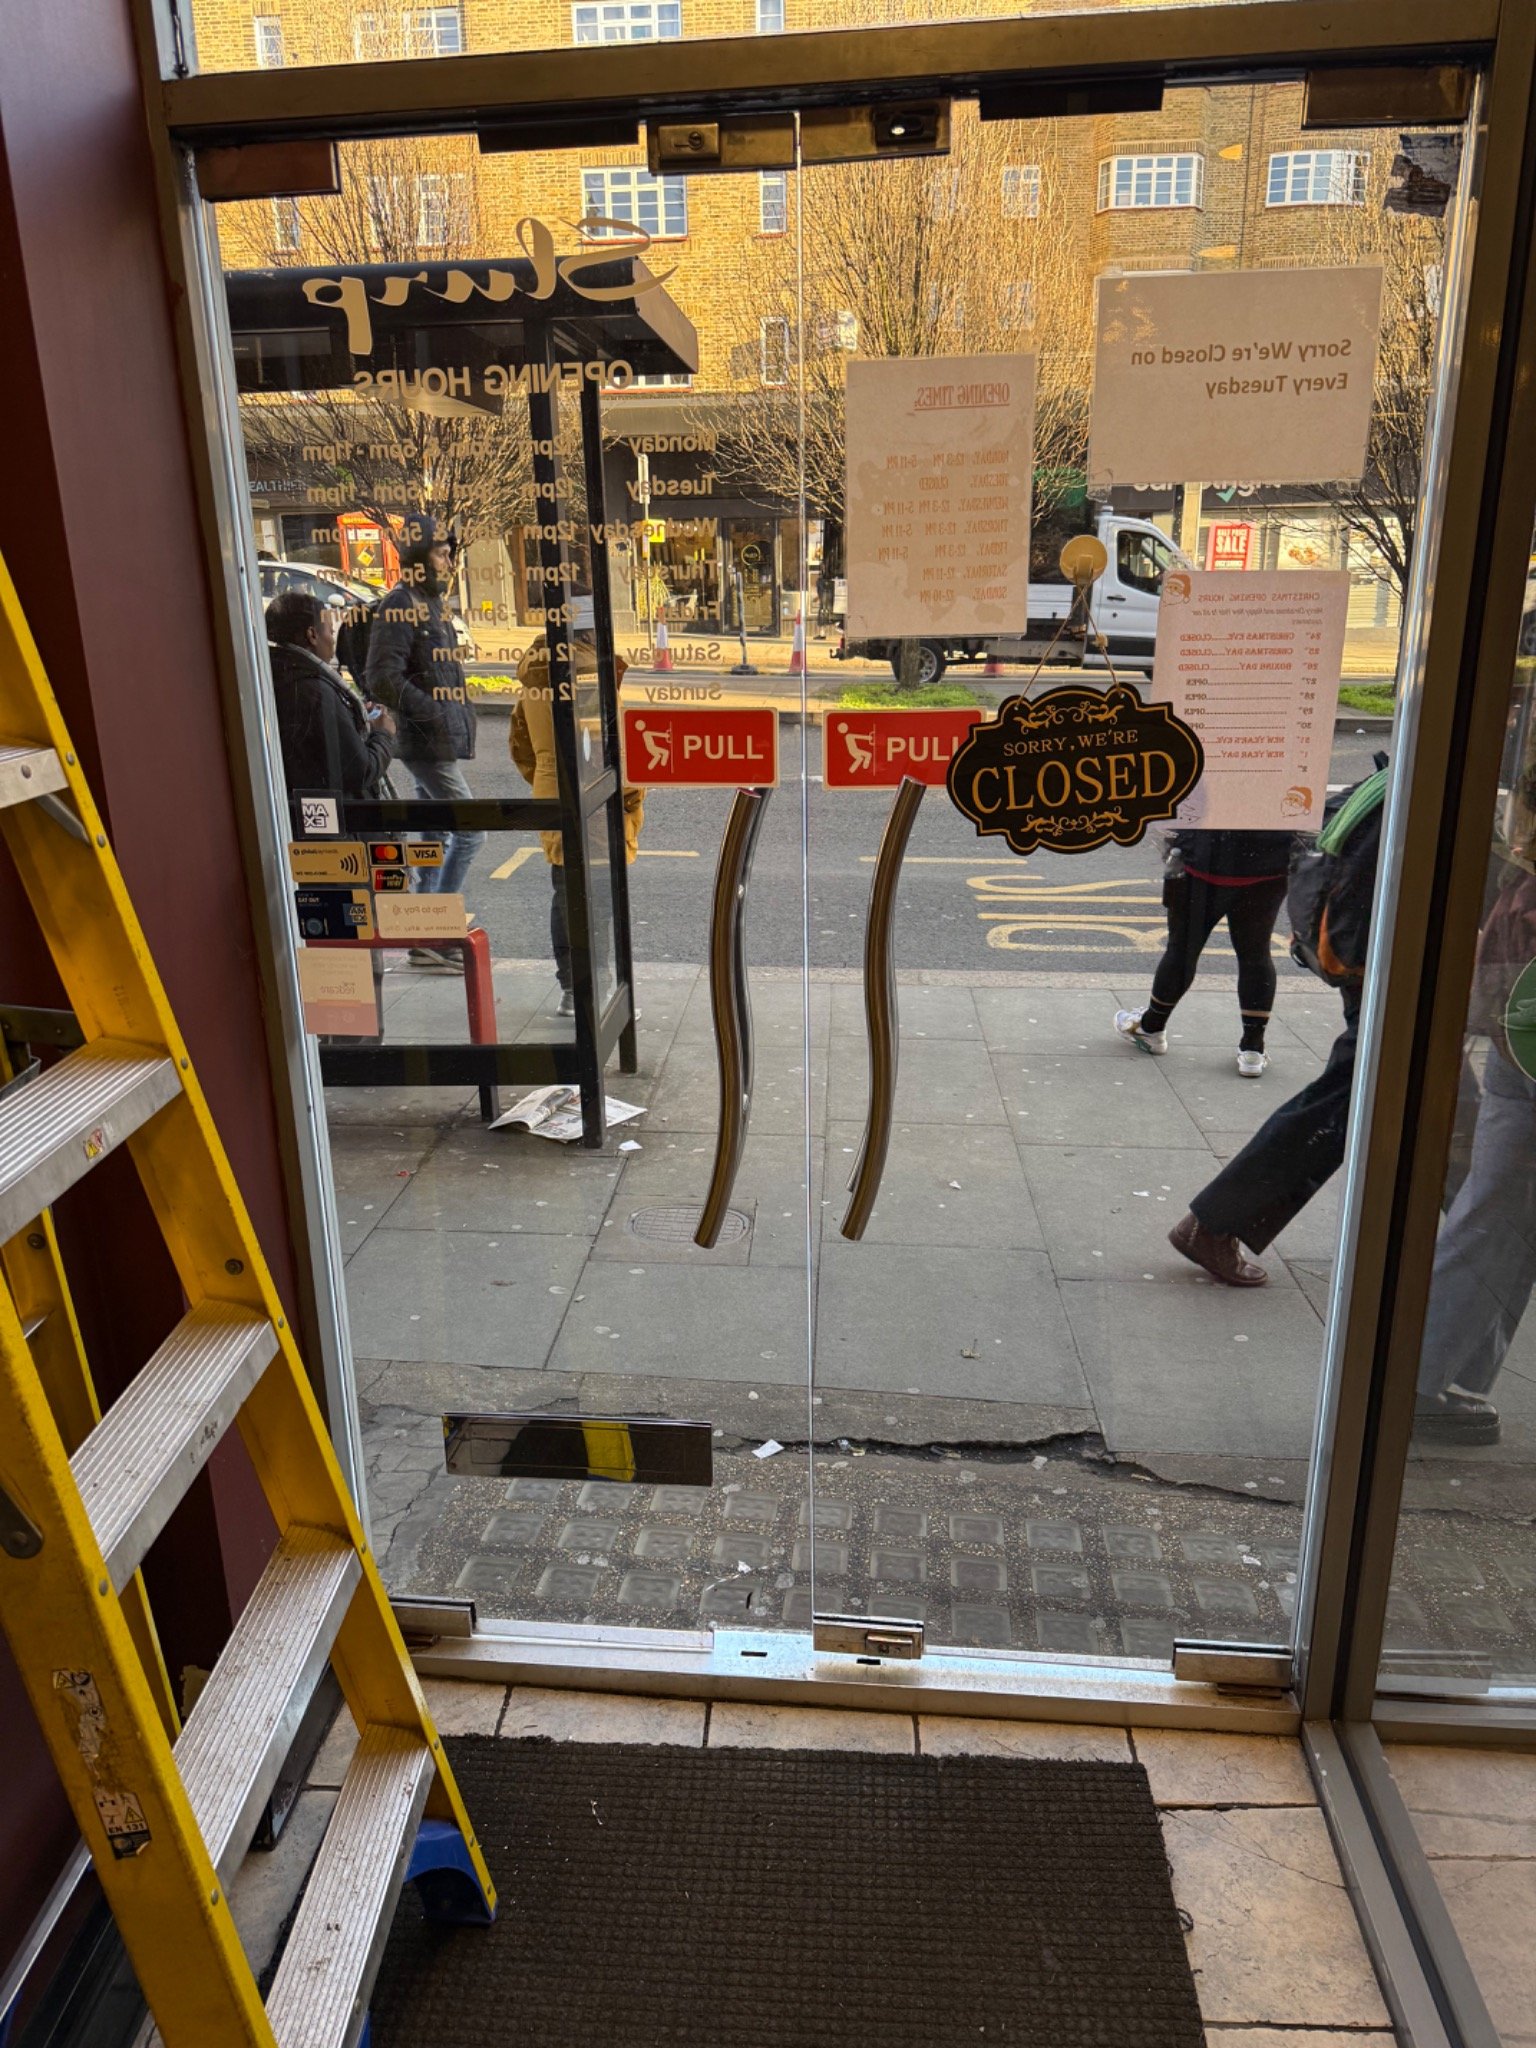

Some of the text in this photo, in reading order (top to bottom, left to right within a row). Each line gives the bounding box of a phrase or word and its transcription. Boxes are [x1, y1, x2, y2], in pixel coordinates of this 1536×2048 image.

[1215, 536, 1247, 554] SALE
[682, 733, 765, 761] PULL
[971, 750, 1176, 816] CLOSED
[414, 850, 438, 859] VISA
